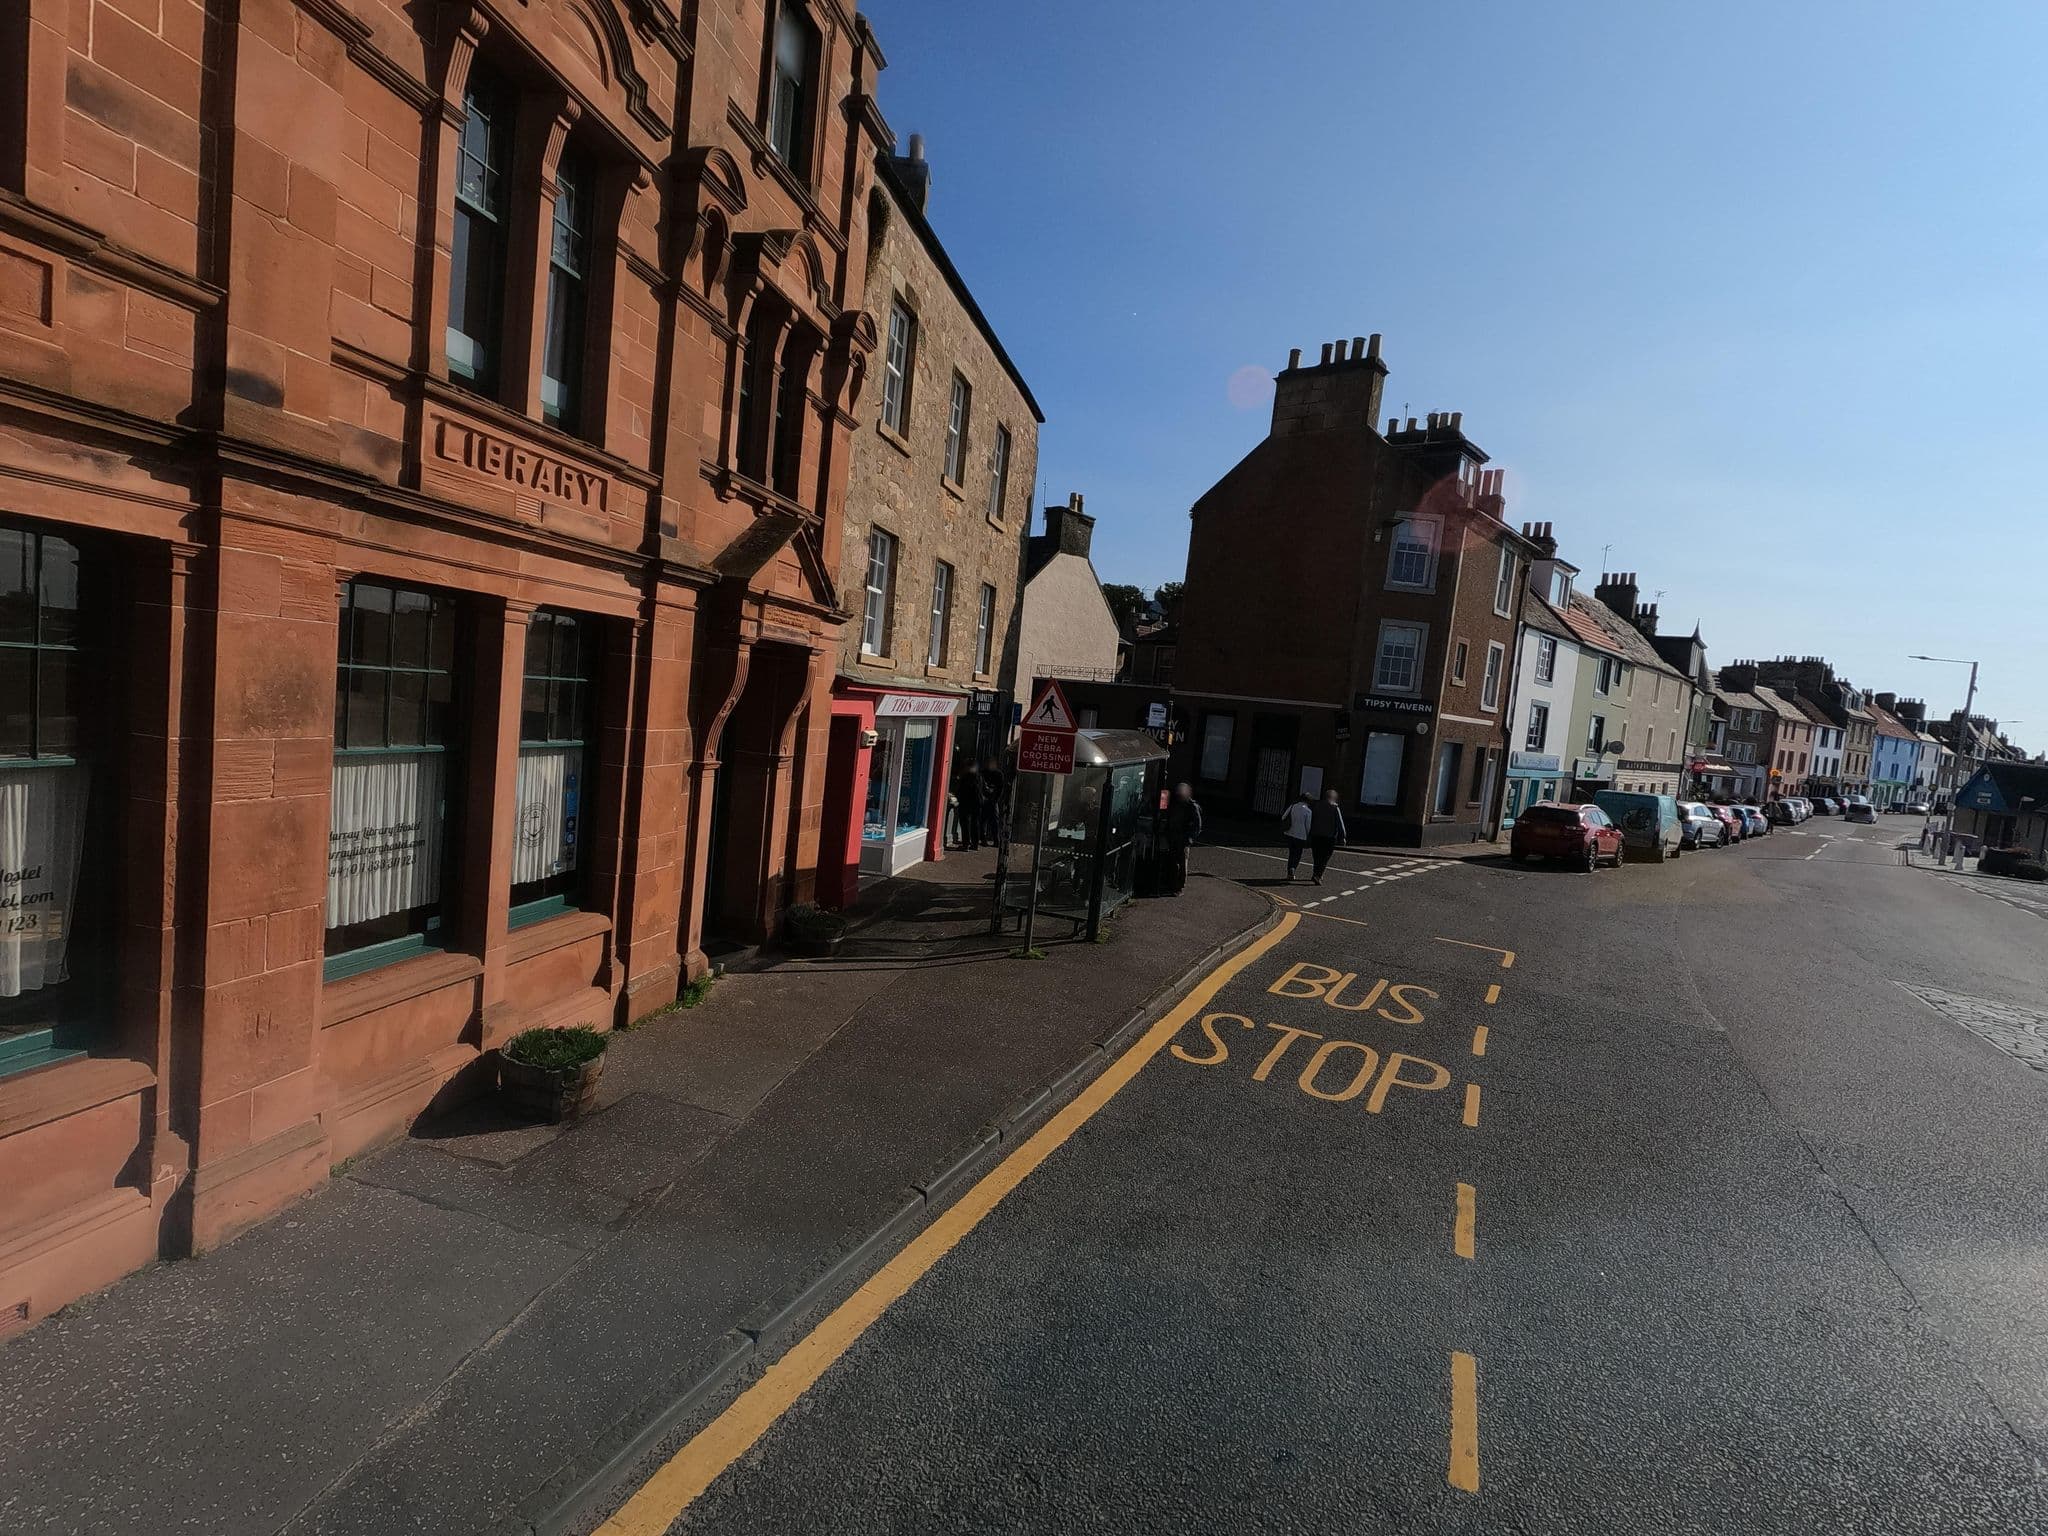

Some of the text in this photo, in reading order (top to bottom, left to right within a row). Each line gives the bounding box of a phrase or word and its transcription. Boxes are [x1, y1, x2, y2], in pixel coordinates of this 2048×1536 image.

[434, 419, 598, 507] LIBRARY
[1364, 698, 1433, 713] TIPSY TAVERN
[1037, 734, 1059, 744] NEW
[1032, 743, 1062, 753] ZEBRA
[1022, 750, 1071, 762] CROSSING
[1031, 760, 1061, 770] AHEAD
[1266, 962, 1440, 1025] BUS
[1170, 1012, 1451, 1114] STOP
